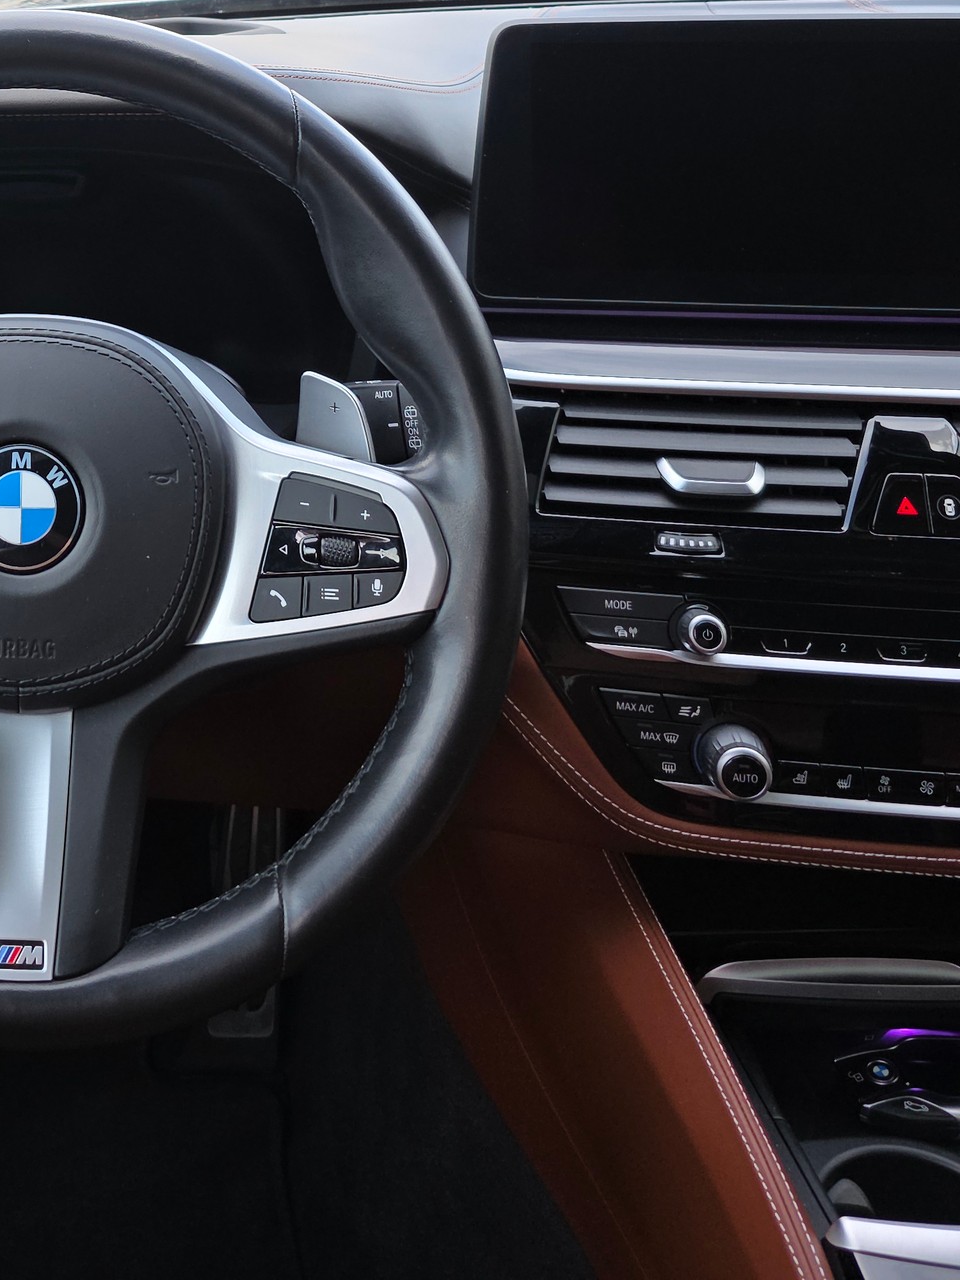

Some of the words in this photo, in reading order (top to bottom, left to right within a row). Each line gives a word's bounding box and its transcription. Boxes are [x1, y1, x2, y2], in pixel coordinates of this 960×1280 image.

[374, 389, 393, 399] AUTO
[404, 419, 419, 428] OFF
[407, 427, 419, 436] ON
[604, 599, 633, 611] MODE
[783, 638, 789, 649] 1
[840, 642, 847, 653] 2
[900, 645, 907, 656] 3
[616, 701, 636, 712] MAX
[638, 703, 655, 714] A/C
[640, 731, 661, 742] MAX
[732, 772, 759, 784] AUTO
[877, 785, 892, 793] OFF
